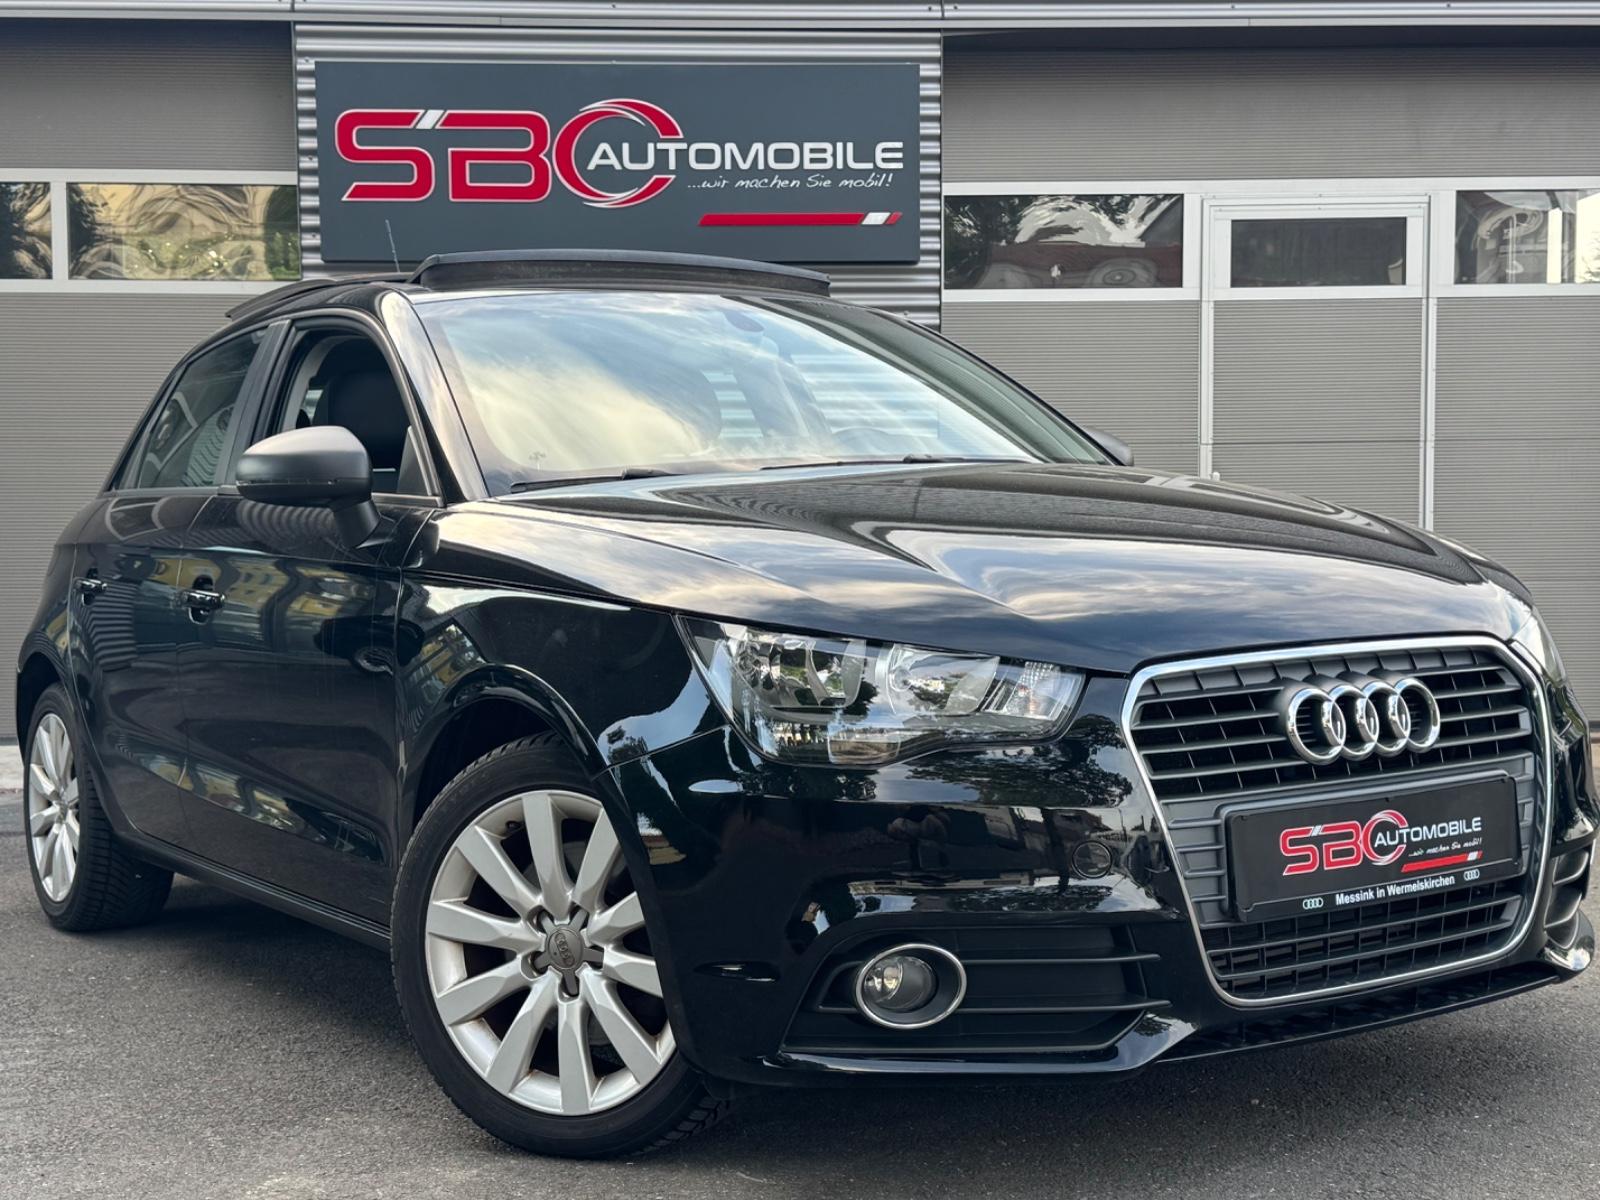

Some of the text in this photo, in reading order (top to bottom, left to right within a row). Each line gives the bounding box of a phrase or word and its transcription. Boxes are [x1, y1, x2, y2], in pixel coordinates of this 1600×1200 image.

[587, 141, 904, 171] AUTOMOBILE
[735, 172, 801, 189] machen
[806, 173, 832, 189] Sie
[838, 172, 894, 189] mobil!
[1374, 816, 1482, 848] AUTOMOBILE
[1335, 875, 1456, 906] Messink in Wermelskirchen
